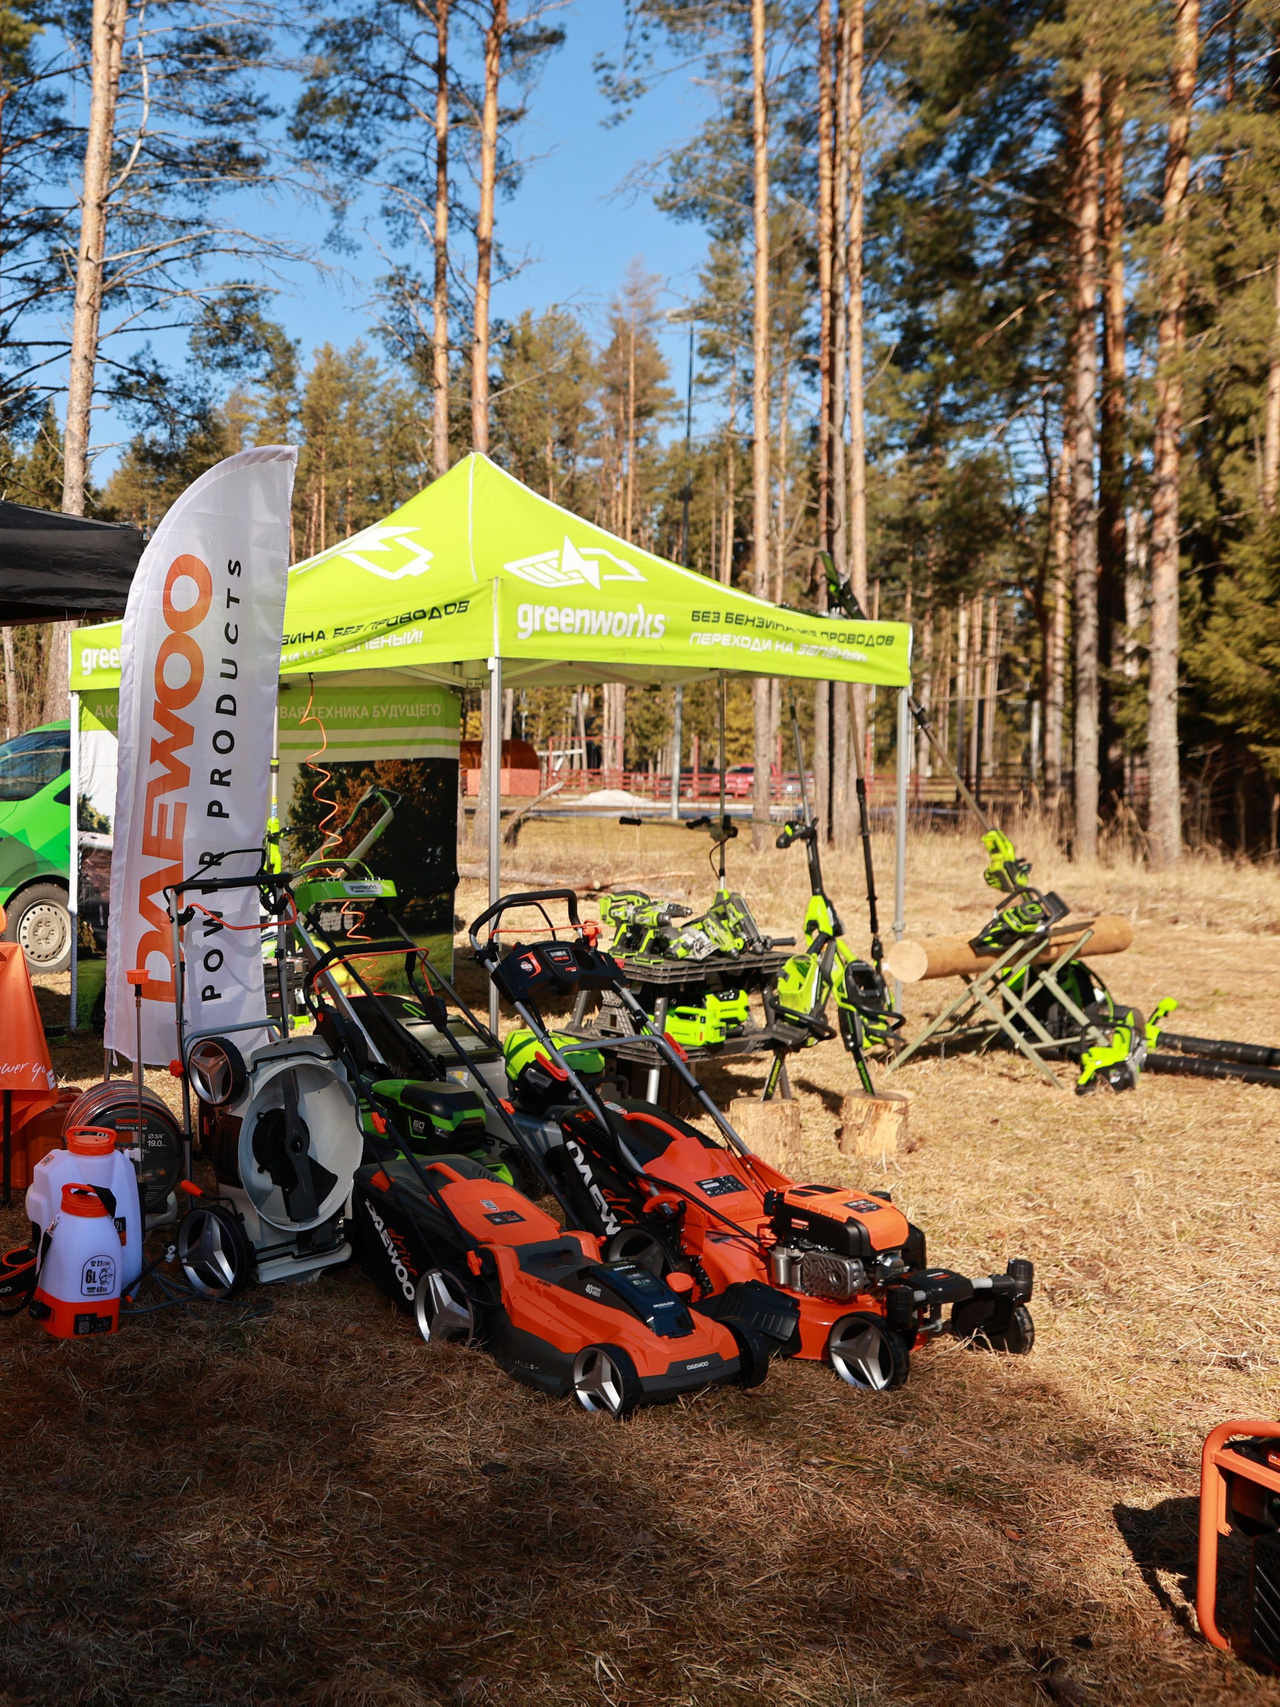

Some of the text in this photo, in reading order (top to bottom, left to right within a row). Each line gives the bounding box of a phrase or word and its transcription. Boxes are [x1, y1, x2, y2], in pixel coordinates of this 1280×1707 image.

[332, 623, 363, 638] БЕЗ
[363, 600, 470, 632] ПРОВОДОВ
[517, 603, 665, 639] greenworks
[691, 610, 720, 623] БЕЗ
[820, 631, 895, 647] ПРОВОДОВ
[335, 629, 424, 655] ЕЛЁНЫЙ!
[689, 631, 772, 652] ПЕРЕХОДИ
[774, 641, 794, 654] НА
[81, 648, 121, 676] gree
[310, 704, 369, 719] ТЕХНИКА
[372, 703, 441, 721] БУДУЩЕГО
[135, 553, 212, 1002] DAEWOO
[198, 558, 241, 1002] POWR PRODUCTS
[365, 1198, 415, 1302] DAEWOO
[86, 1269, 97, 1283] 6L
[686, 1361, 710, 1371] DAEWOO
